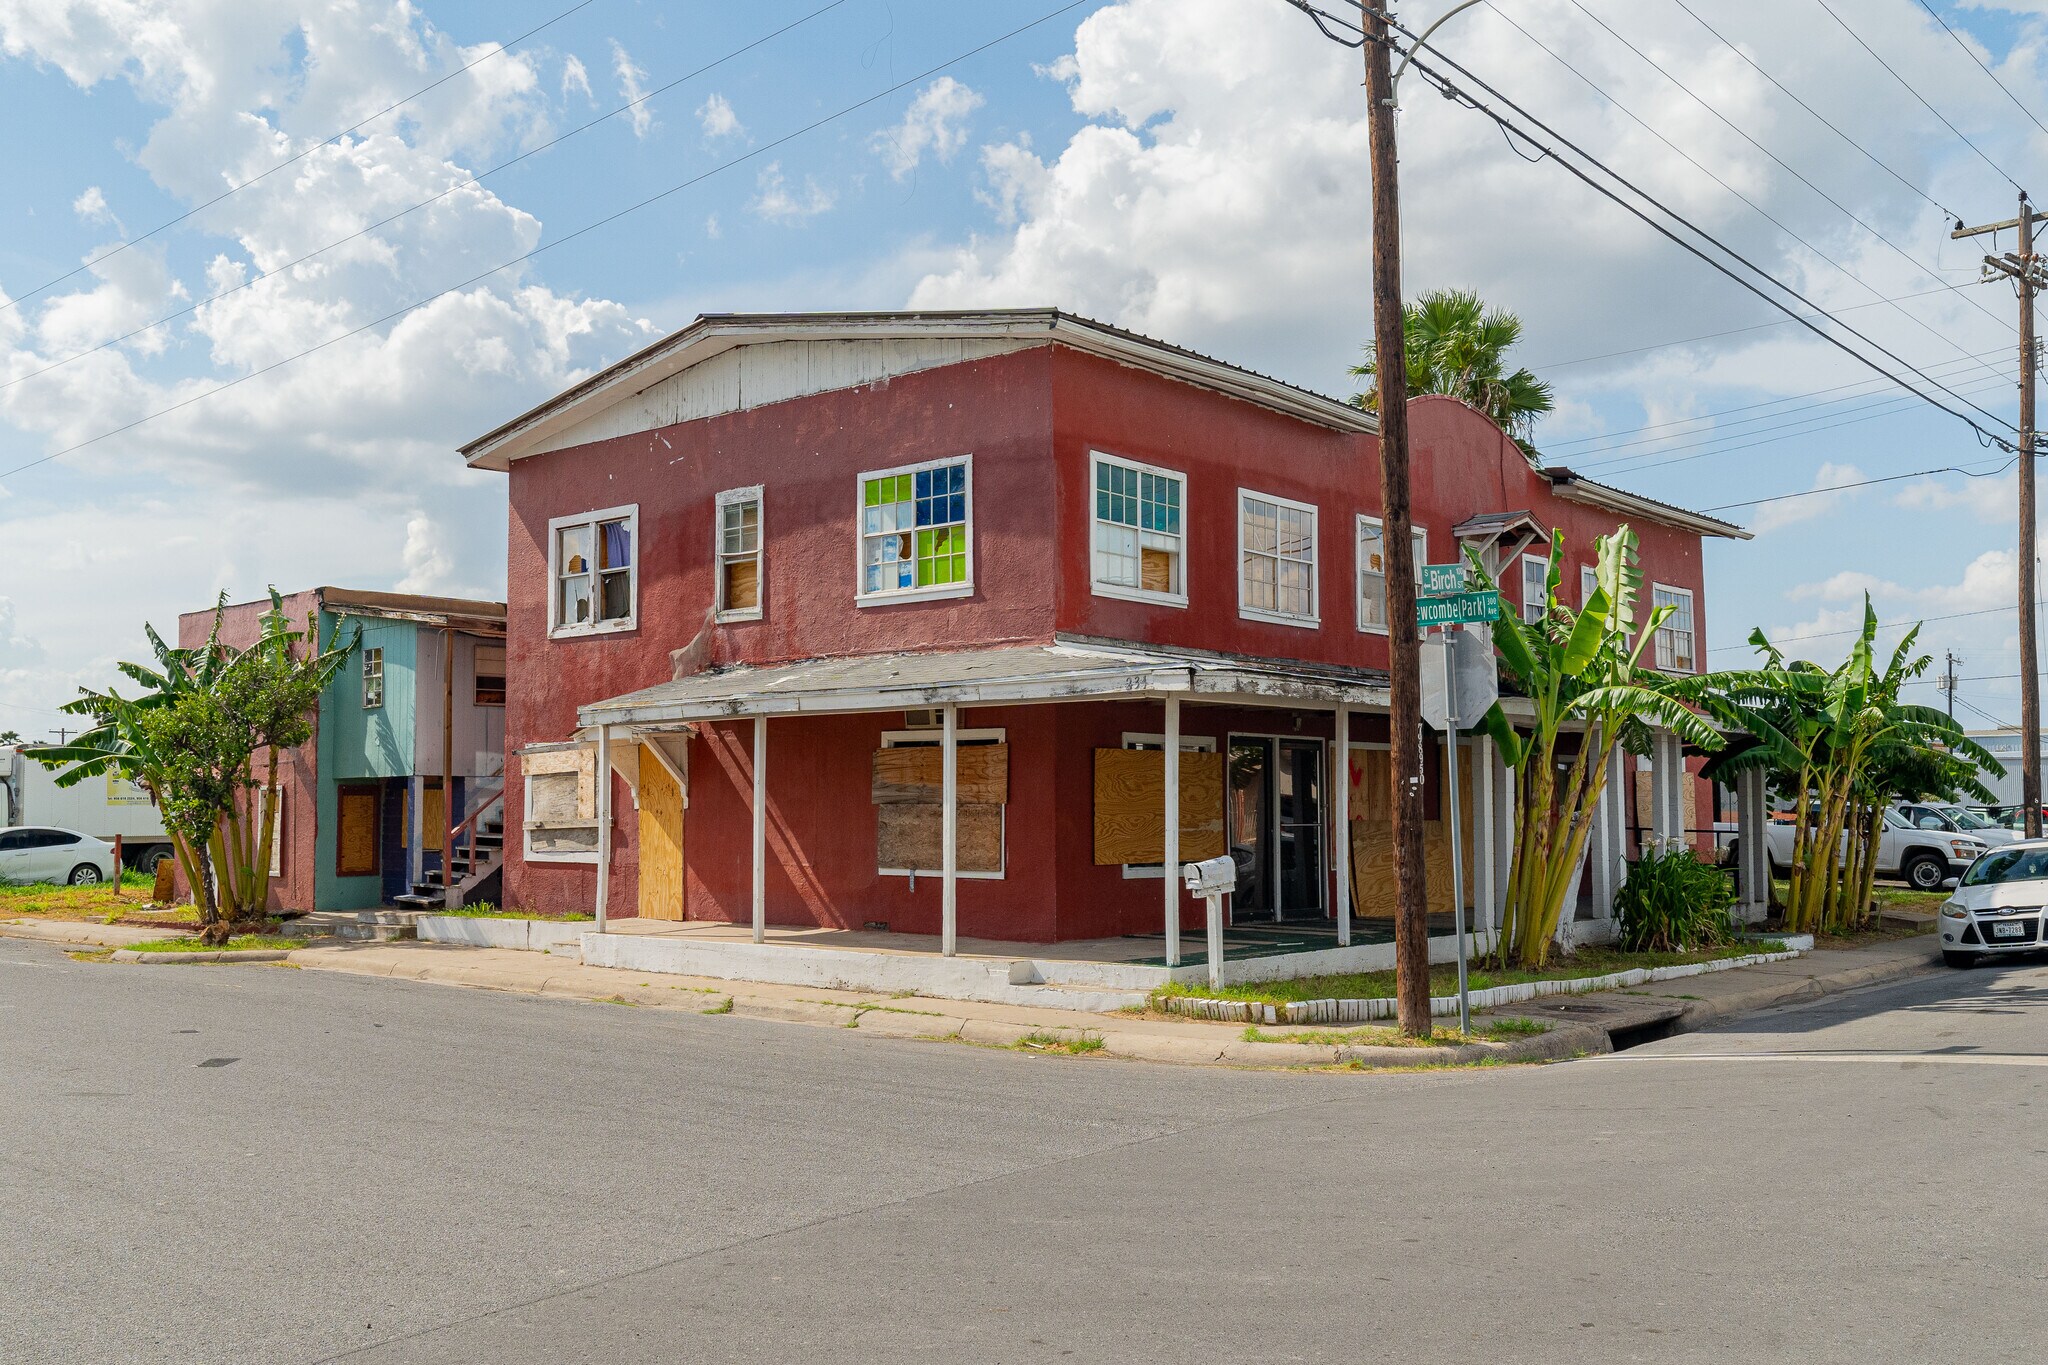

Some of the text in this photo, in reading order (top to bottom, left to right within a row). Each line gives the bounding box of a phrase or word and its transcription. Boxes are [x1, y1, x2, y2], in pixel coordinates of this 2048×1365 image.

[1424, 569, 1429, 577] S
[1430, 569, 1457, 591] Birch
[1416, 595, 1496, 621] ewcombe(Park) 300
[1487, 607, 1497, 615] Ave
